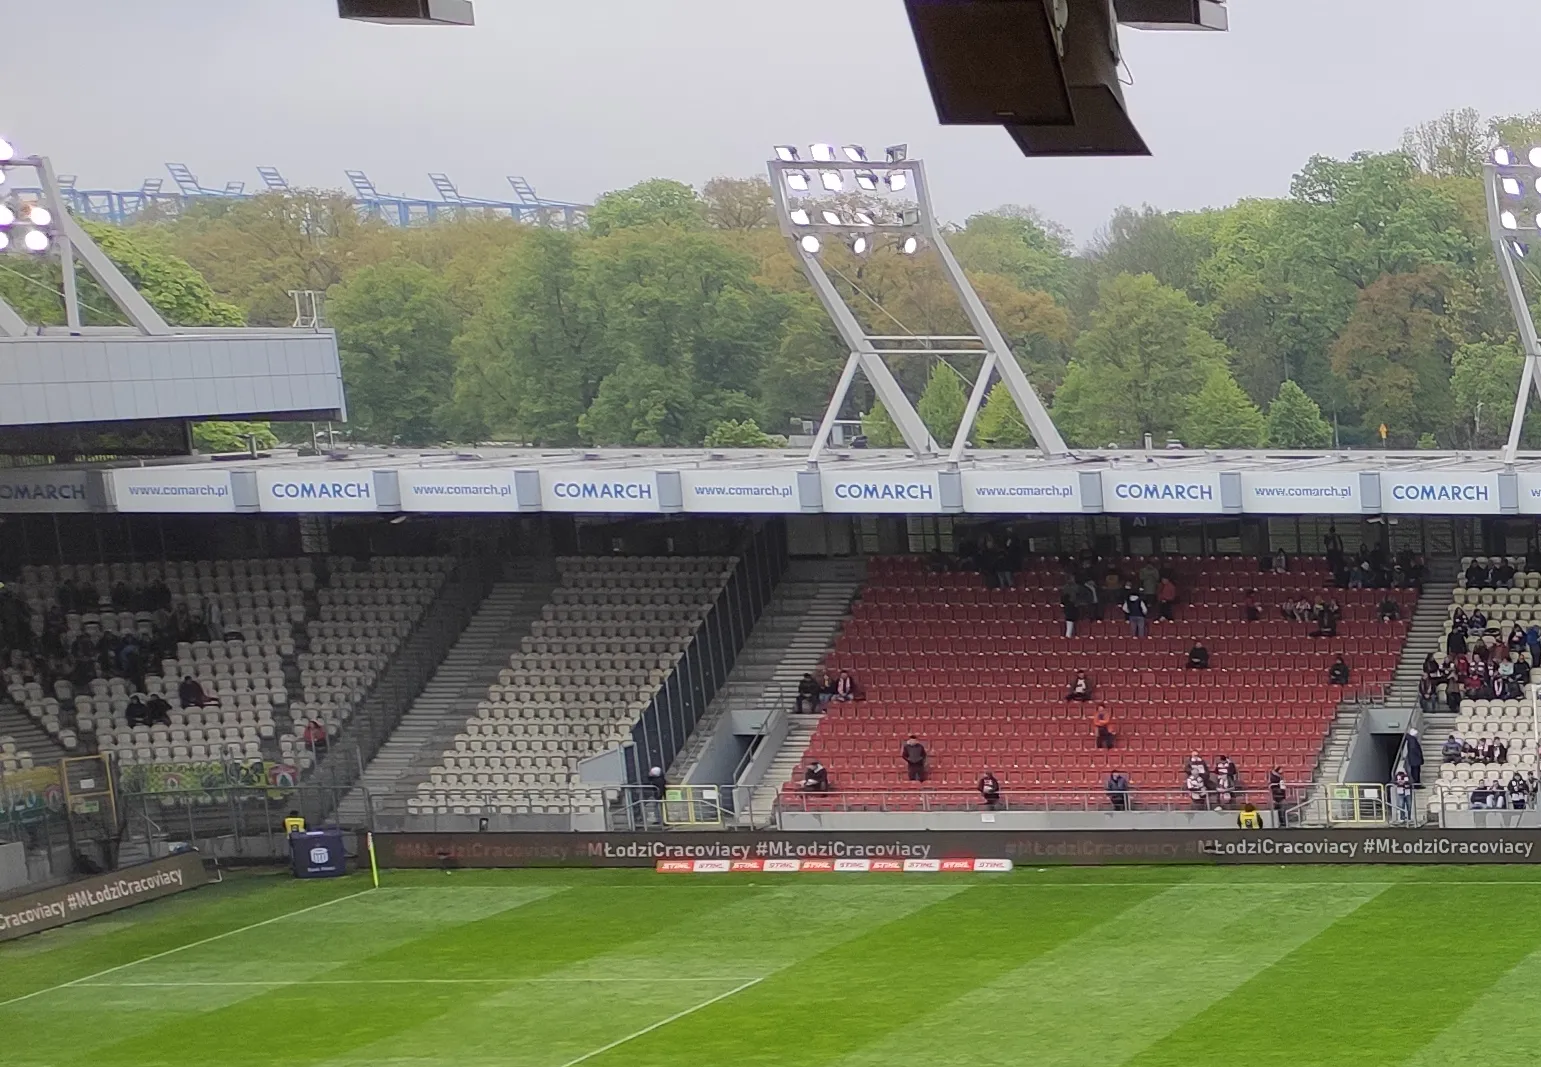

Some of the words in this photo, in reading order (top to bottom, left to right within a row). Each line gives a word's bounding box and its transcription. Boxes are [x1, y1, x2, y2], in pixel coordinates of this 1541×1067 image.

[128, 485, 229, 498] www.comarch.pl
[272, 484, 370, 499] COMARCH
[413, 485, 512, 498] www.comarch.pl
[554, 484, 651, 499] COMARCH
[695, 485, 793, 498] www.comarch.pl
[835, 484, 933, 499] COMARCH
[976, 485, 1074, 498] www.comarch.pl
[1115, 484, 1213, 499] COMARCH
[1255, 485, 1352, 499] www.comarch.pl
[1392, 486, 1490, 500] COMARCH
[576, 841, 750, 860] #MŁodziCracoviacy
[756, 840, 931, 860] #MŁodziCracoviacy
[1184, 838, 1359, 858] #MŁodziCracoviacy
[1363, 837, 1534, 858] #MŁodziCracoviacy
[68, 868, 183, 911] #MŁodziCracoviacy
